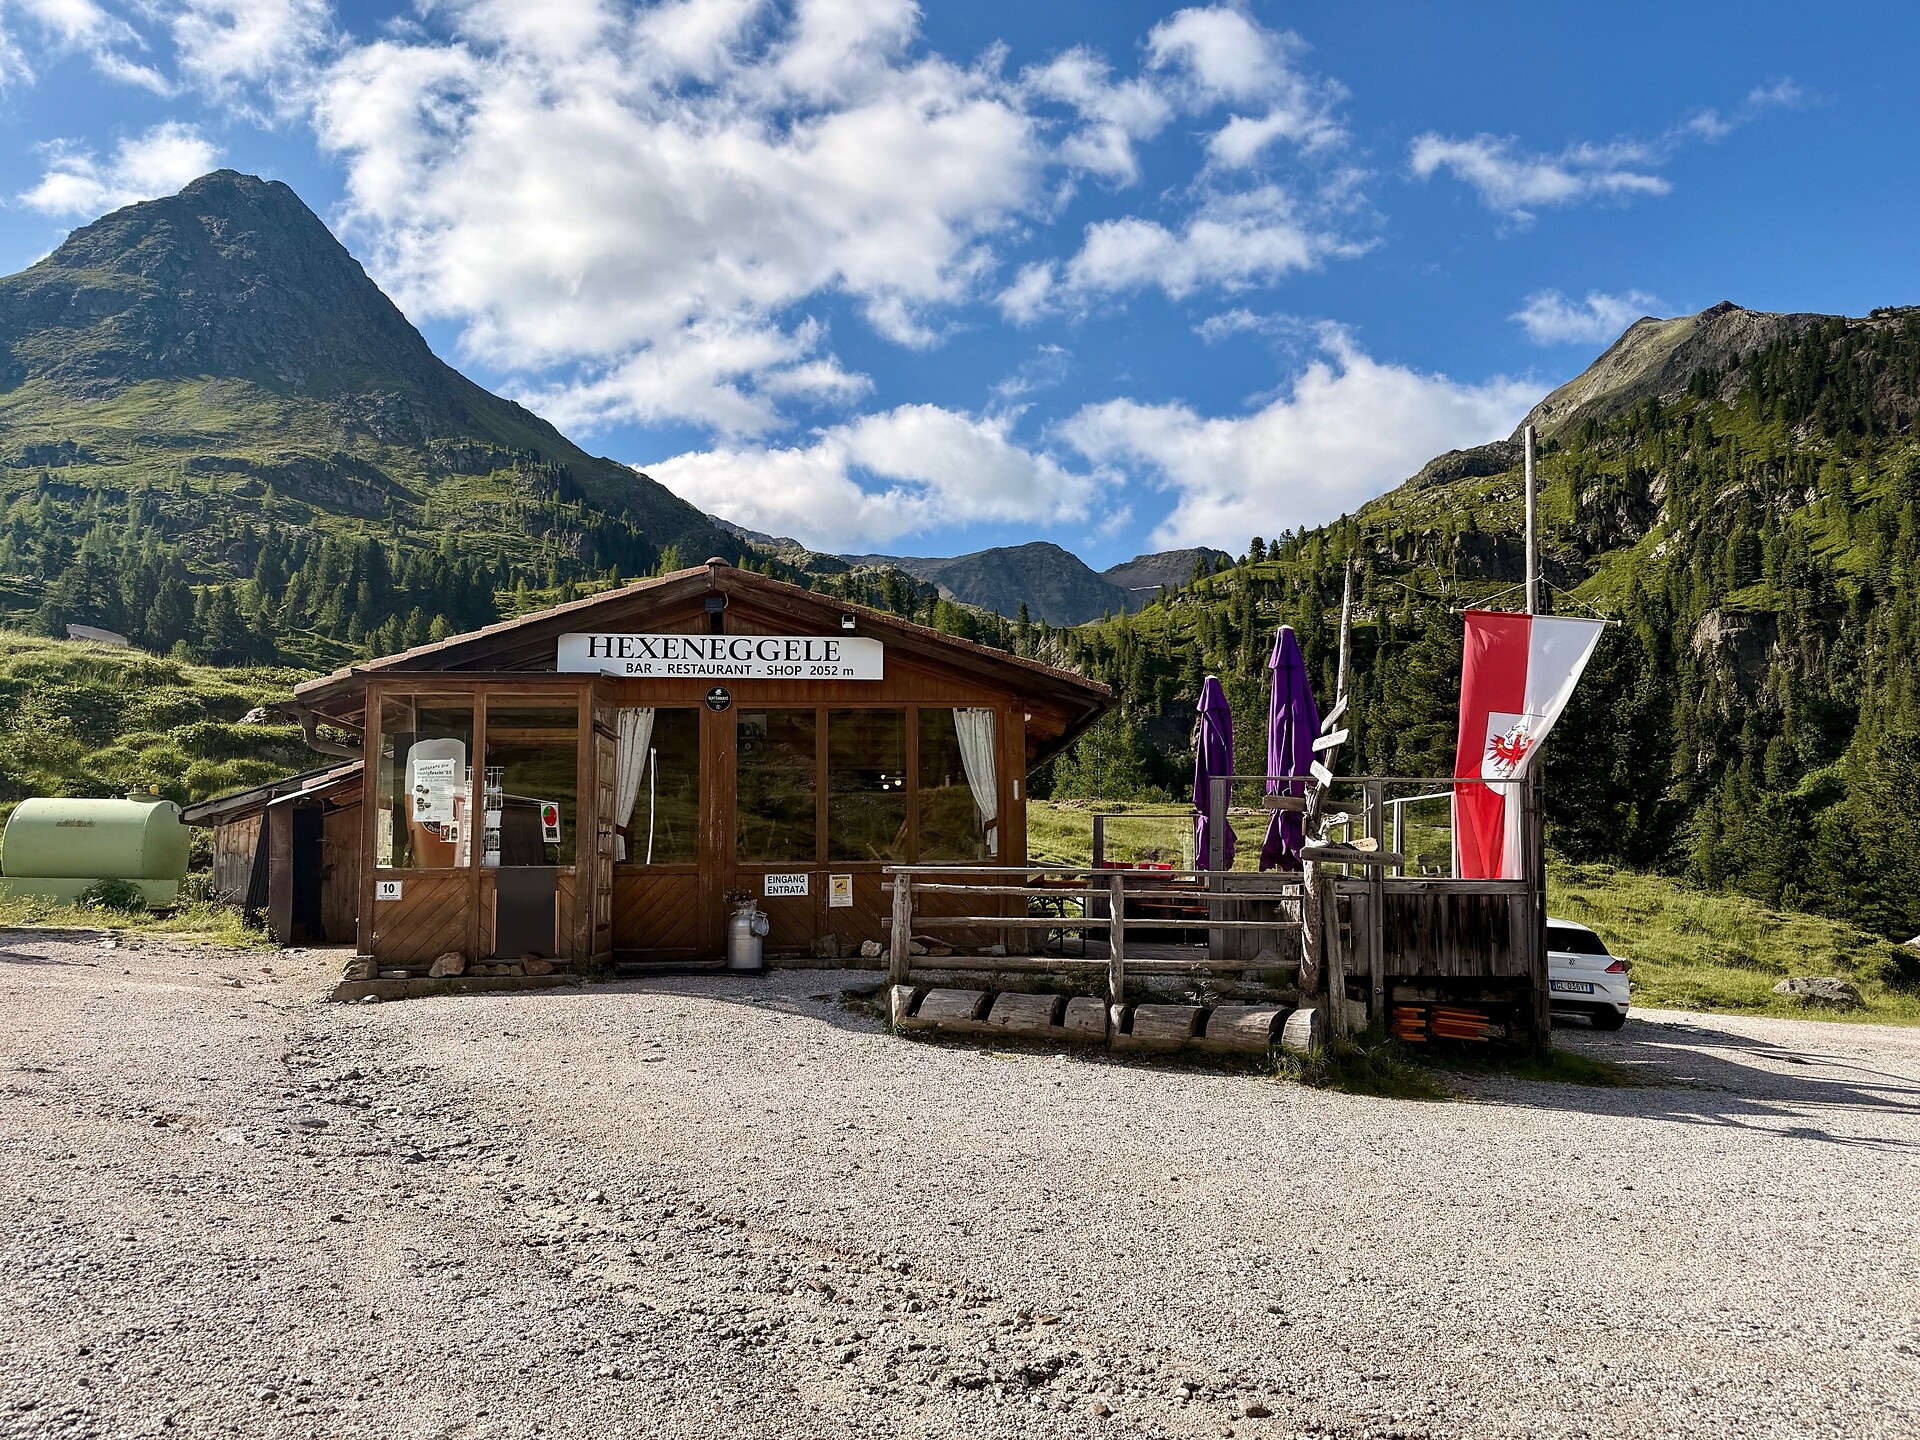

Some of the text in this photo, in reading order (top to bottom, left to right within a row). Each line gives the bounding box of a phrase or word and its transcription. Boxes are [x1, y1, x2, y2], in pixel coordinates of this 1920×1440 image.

[587, 636, 841, 662] HEXENEGGELE
[625, 662, 653, 675] BAR
[667, 663, 752, 675] RESTAURANT
[766, 665, 803, 676] SHOP
[809, 665, 838, 676] 2052
[842, 668, 854, 676] m
[767, 875, 805, 884] EINGANG
[383, 883, 395, 894] 10
[767, 885, 805, 894] ENTRATA
